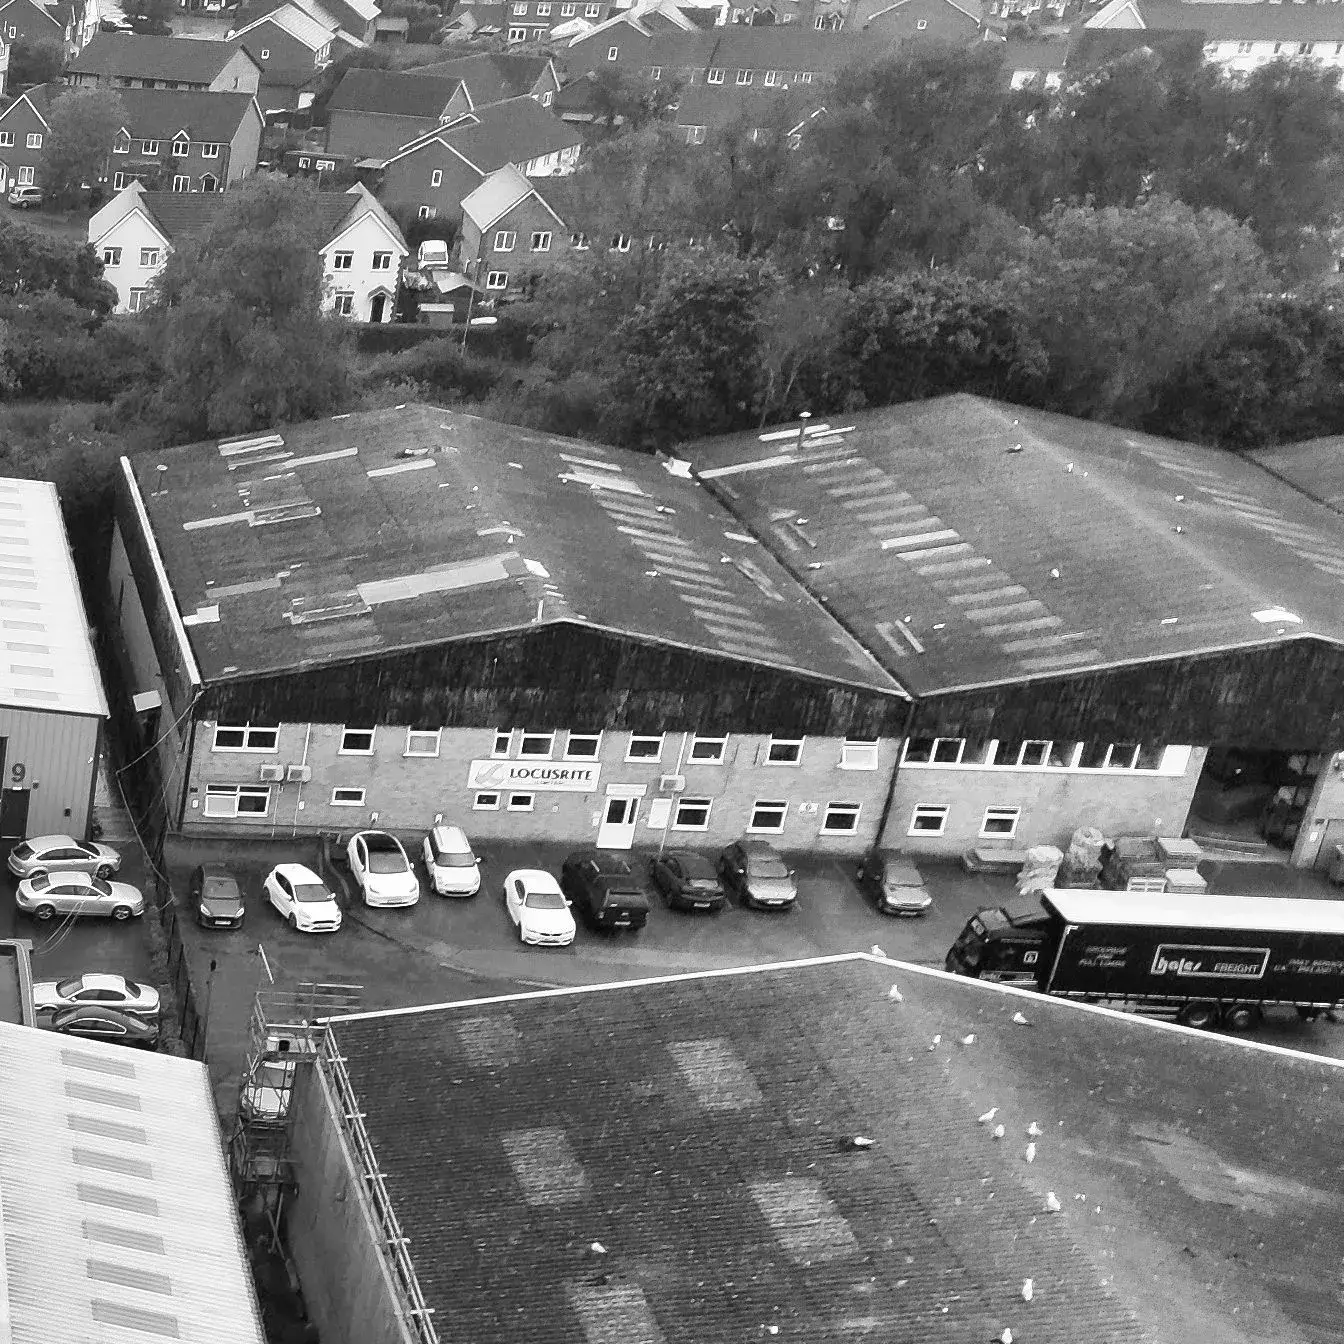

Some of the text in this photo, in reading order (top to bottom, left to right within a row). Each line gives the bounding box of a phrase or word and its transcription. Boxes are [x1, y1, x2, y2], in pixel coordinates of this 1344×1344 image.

[11, 762, 26, 783] 9
[509, 768, 593, 781] LOCUSRITE
[1213, 963, 1260, 973] FREIGHT
